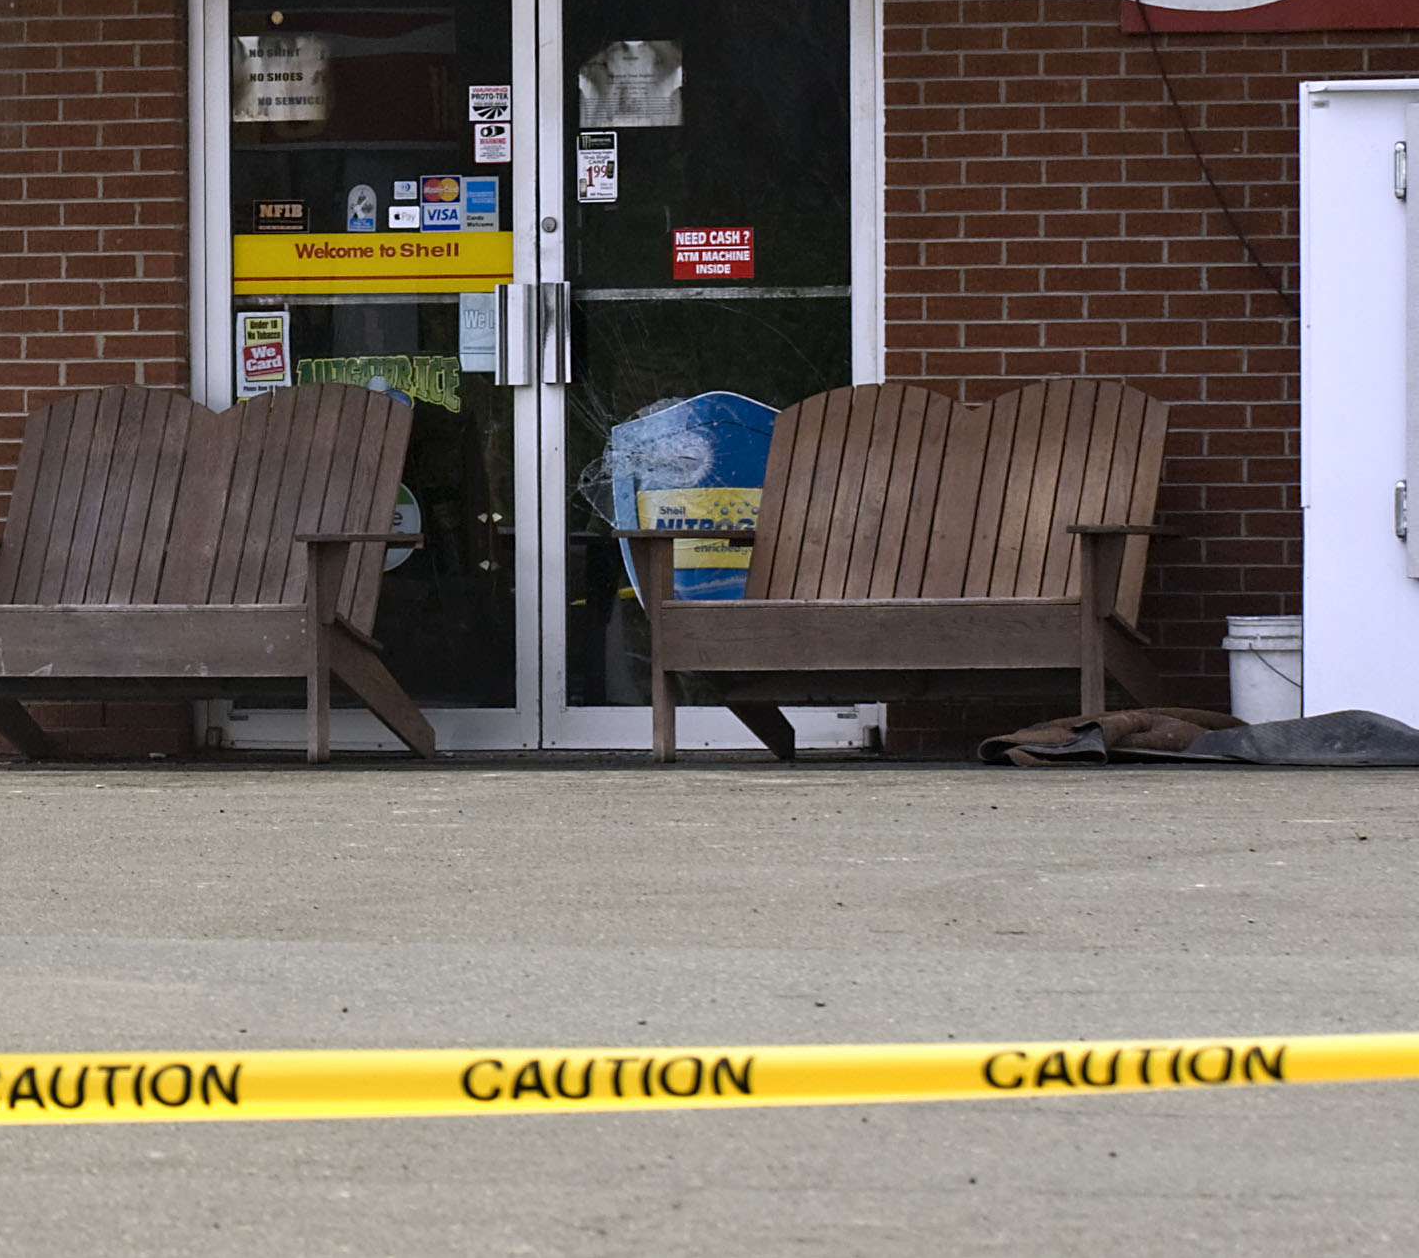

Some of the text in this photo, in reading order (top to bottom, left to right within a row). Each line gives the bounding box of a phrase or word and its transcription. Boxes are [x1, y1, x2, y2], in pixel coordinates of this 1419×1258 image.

[249, 49, 265, 58] NO
[250, 72, 303, 82] NO SHOES
[258, 97, 272, 106] NO
[427, 208, 458, 221] VISA
[675, 232, 707, 245] NEED
[709, 231, 740, 245] CASH
[295, 242, 460, 259] Welcome to Shell
[676, 251, 751, 262] ATM MACHINE
[696, 263, 731, 275] INSIDE
[465, 309, 486, 330] We
[250, 345, 276, 359] We
[246, 355, 284, 372] Card
[660, 505, 686, 515] Shell
[983, 1045, 1288, 1092] CAUTION
[461, 1055, 754, 1103] CAUTION
